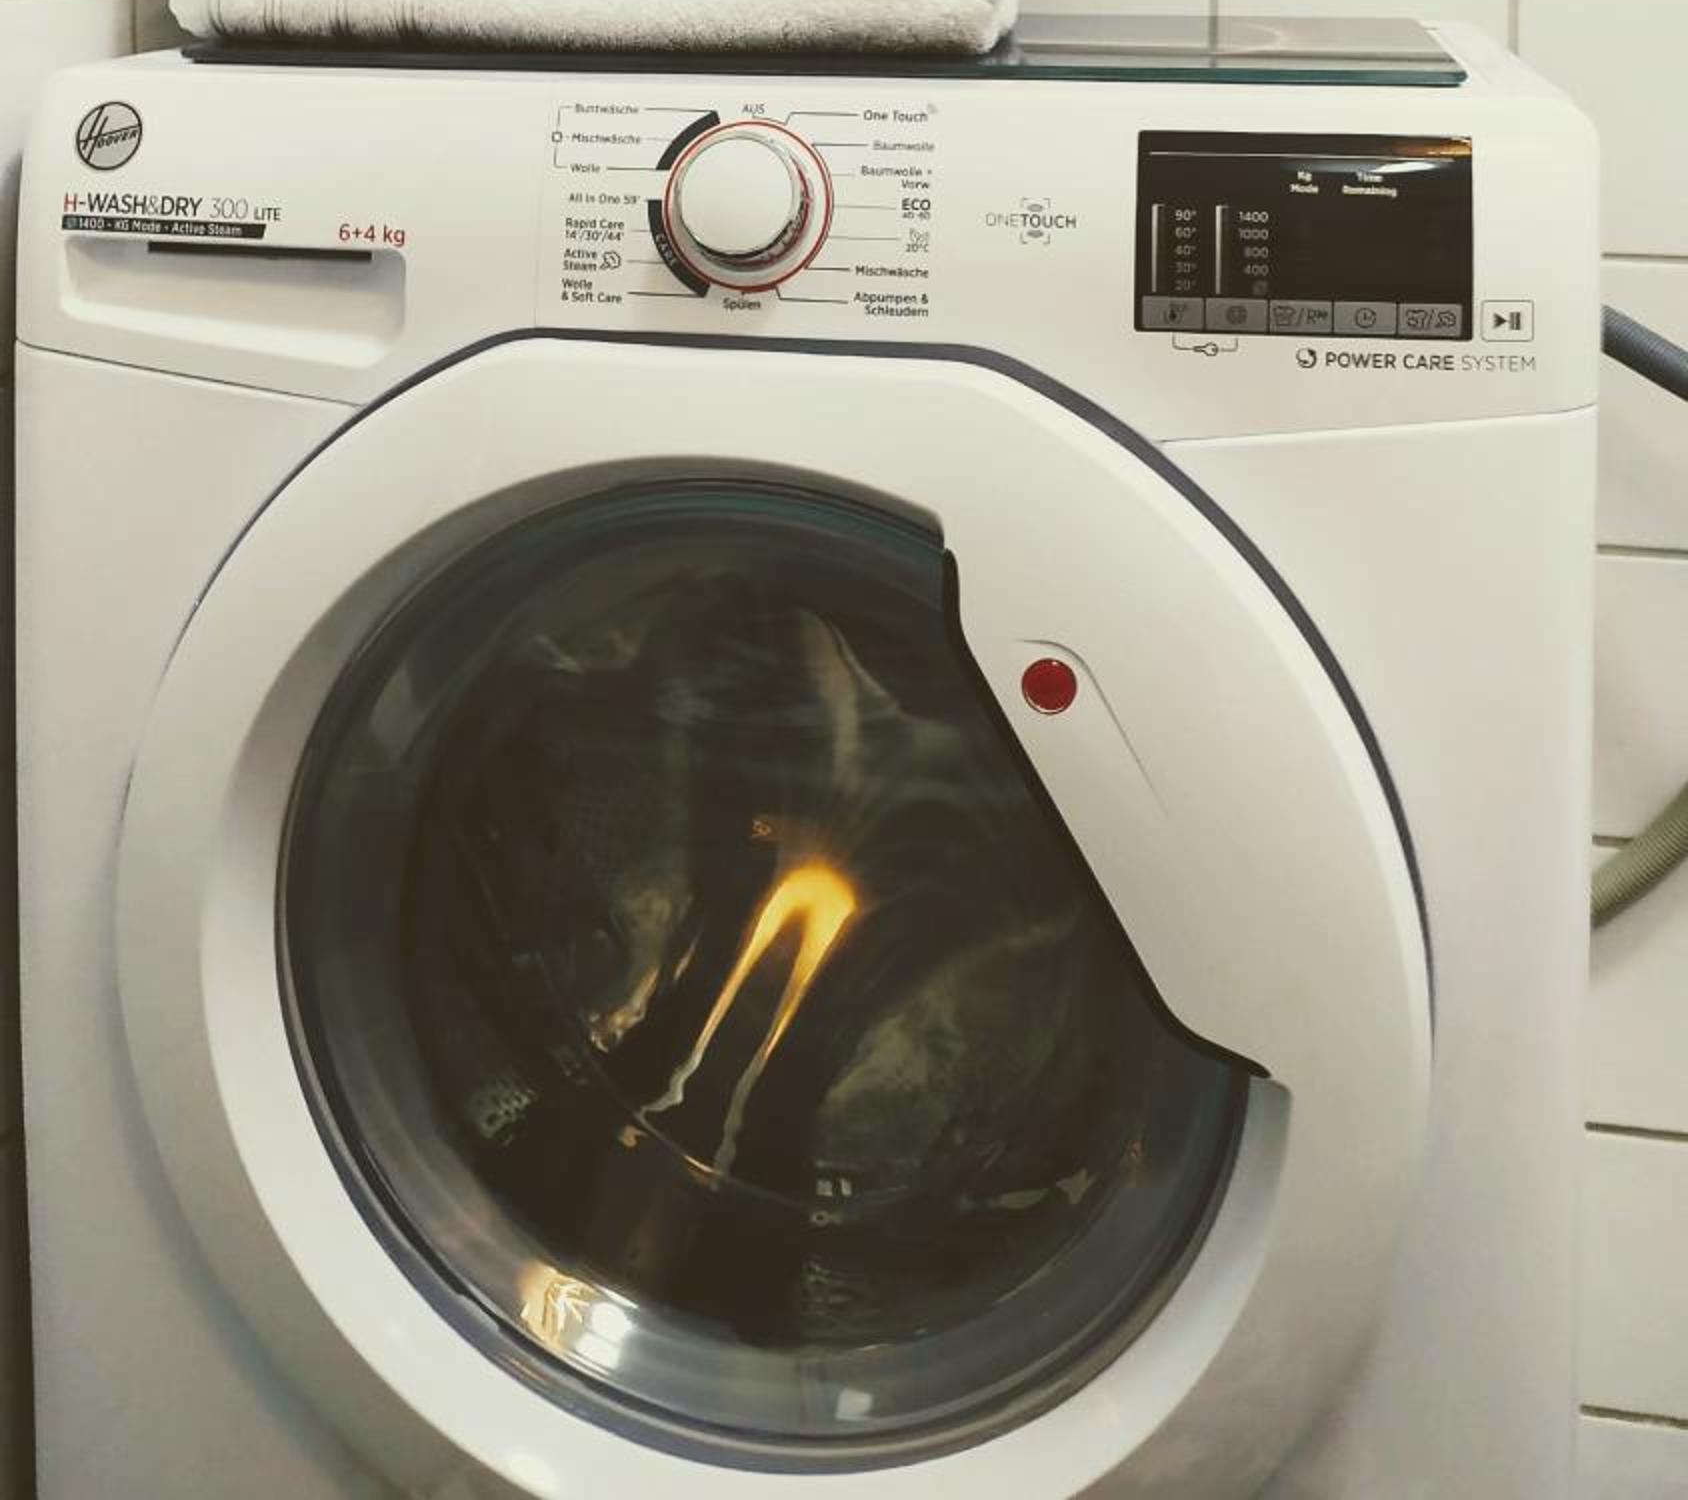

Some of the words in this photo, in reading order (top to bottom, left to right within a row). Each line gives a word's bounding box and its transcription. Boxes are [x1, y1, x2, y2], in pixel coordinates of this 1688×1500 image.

[741, 103, 765, 114] AUS
[864, 109, 888, 121] One
[893, 109, 928, 122] Touch
[570, 164, 600, 173] Wolle
[861, 165, 923, 176] Baumwolle
[1290, 183, 1319, 194] Mode
[569, 192, 582, 202] All
[599, 193, 621, 204] One
[64, 193, 203, 217] H-WASH&DRY
[209, 197, 249, 220] 300
[254, 206, 282, 222] LITE
[901, 198, 931, 211] ECO
[1175, 209, 1197, 221] 90°
[1239, 211, 1269, 223] 1400
[79, 218, 105, 229] 1400
[114, 219, 129, 230] KG
[132, 220, 161, 233] Mode
[171, 222, 206, 235] Active
[208, 223, 243, 236] Steam
[565, 218, 597, 230] Rapid
[600, 219, 624, 230] Care
[339, 223, 375, 241] 6+4
[384, 225, 405, 248] kg
[1175, 227, 1197, 238] 60°
[1239, 228, 1269, 240] 1000
[563, 248, 597, 259] Active
[562, 260, 597, 271] Steam
[855, 265, 929, 278] Mischwäsche
[1244, 264, 1269, 276] 400
[562, 278, 593, 290] Wolle
[561, 290, 569, 301] &
[571, 291, 594, 302] Soft
[597, 292, 623, 304] Care
[853, 292, 917, 305] Abpumpen
[921, 293, 929, 304] &
[722, 297, 761, 311] Spülen
[864, 304, 929, 317] Schleudern
[1325, 352, 1396, 369] POWER
[1403, 354, 1455, 371] CARE
[1461, 355, 1536, 372] SYSTEM
